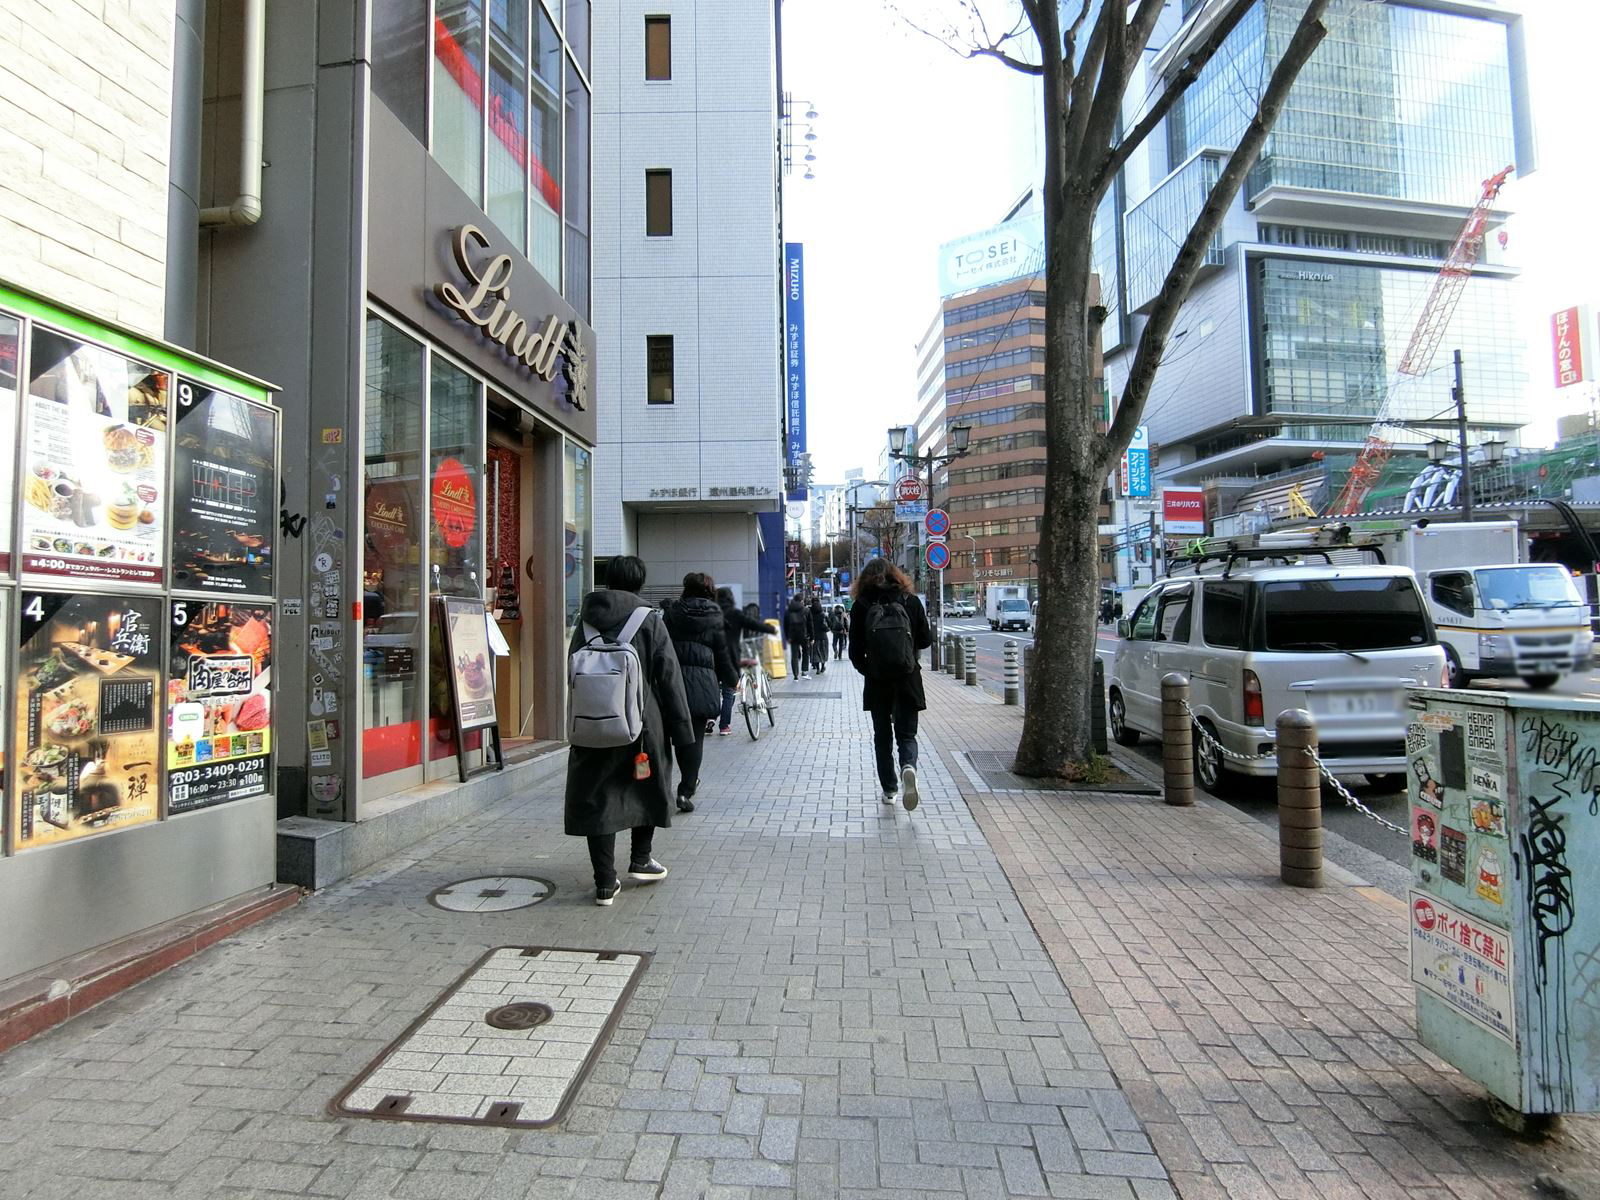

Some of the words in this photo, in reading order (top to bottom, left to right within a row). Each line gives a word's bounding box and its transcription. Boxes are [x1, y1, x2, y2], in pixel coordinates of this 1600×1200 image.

[955, 238, 1017, 268] TOSEI
[790, 258, 800, 301] MIZUHO
[1298, 270, 1334, 281] Hikarie
[434, 223, 567, 383] Lindt
[789, 324, 799, 367] みずほ証券
[1556, 311, 1577, 384] ほけんの窓口
[179, 384, 193, 407] 9
[790, 373, 800, 435] みずほ信託銀行
[1130, 452, 1140, 492] アイシティ
[440, 479, 464, 501] Lindt
[901, 485, 920, 496] 消火栓
[373, 502, 398, 519] Lindt
[1166, 500, 1201, 508] 三井のリハウス
[981, 568, 1014, 577] りそな銀行
[25, 595, 45, 622] 4
[174, 602, 188, 626] 5
[192, 665, 251, 691] 肉屋の台所
[1467, 711, 1494, 726] HENKA
[1468, 724, 1494, 738] BAMS
[1468, 735, 1496, 750] GNASH
[184, 758, 265, 783] 03-3409-0291
[189, 783, 209, 796] 16:00
[217, 778, 237, 790] 23:30
[1473, 774, 1498, 792] HENKA
[1438, 912, 1505, 967] ポイ捨て禁止
